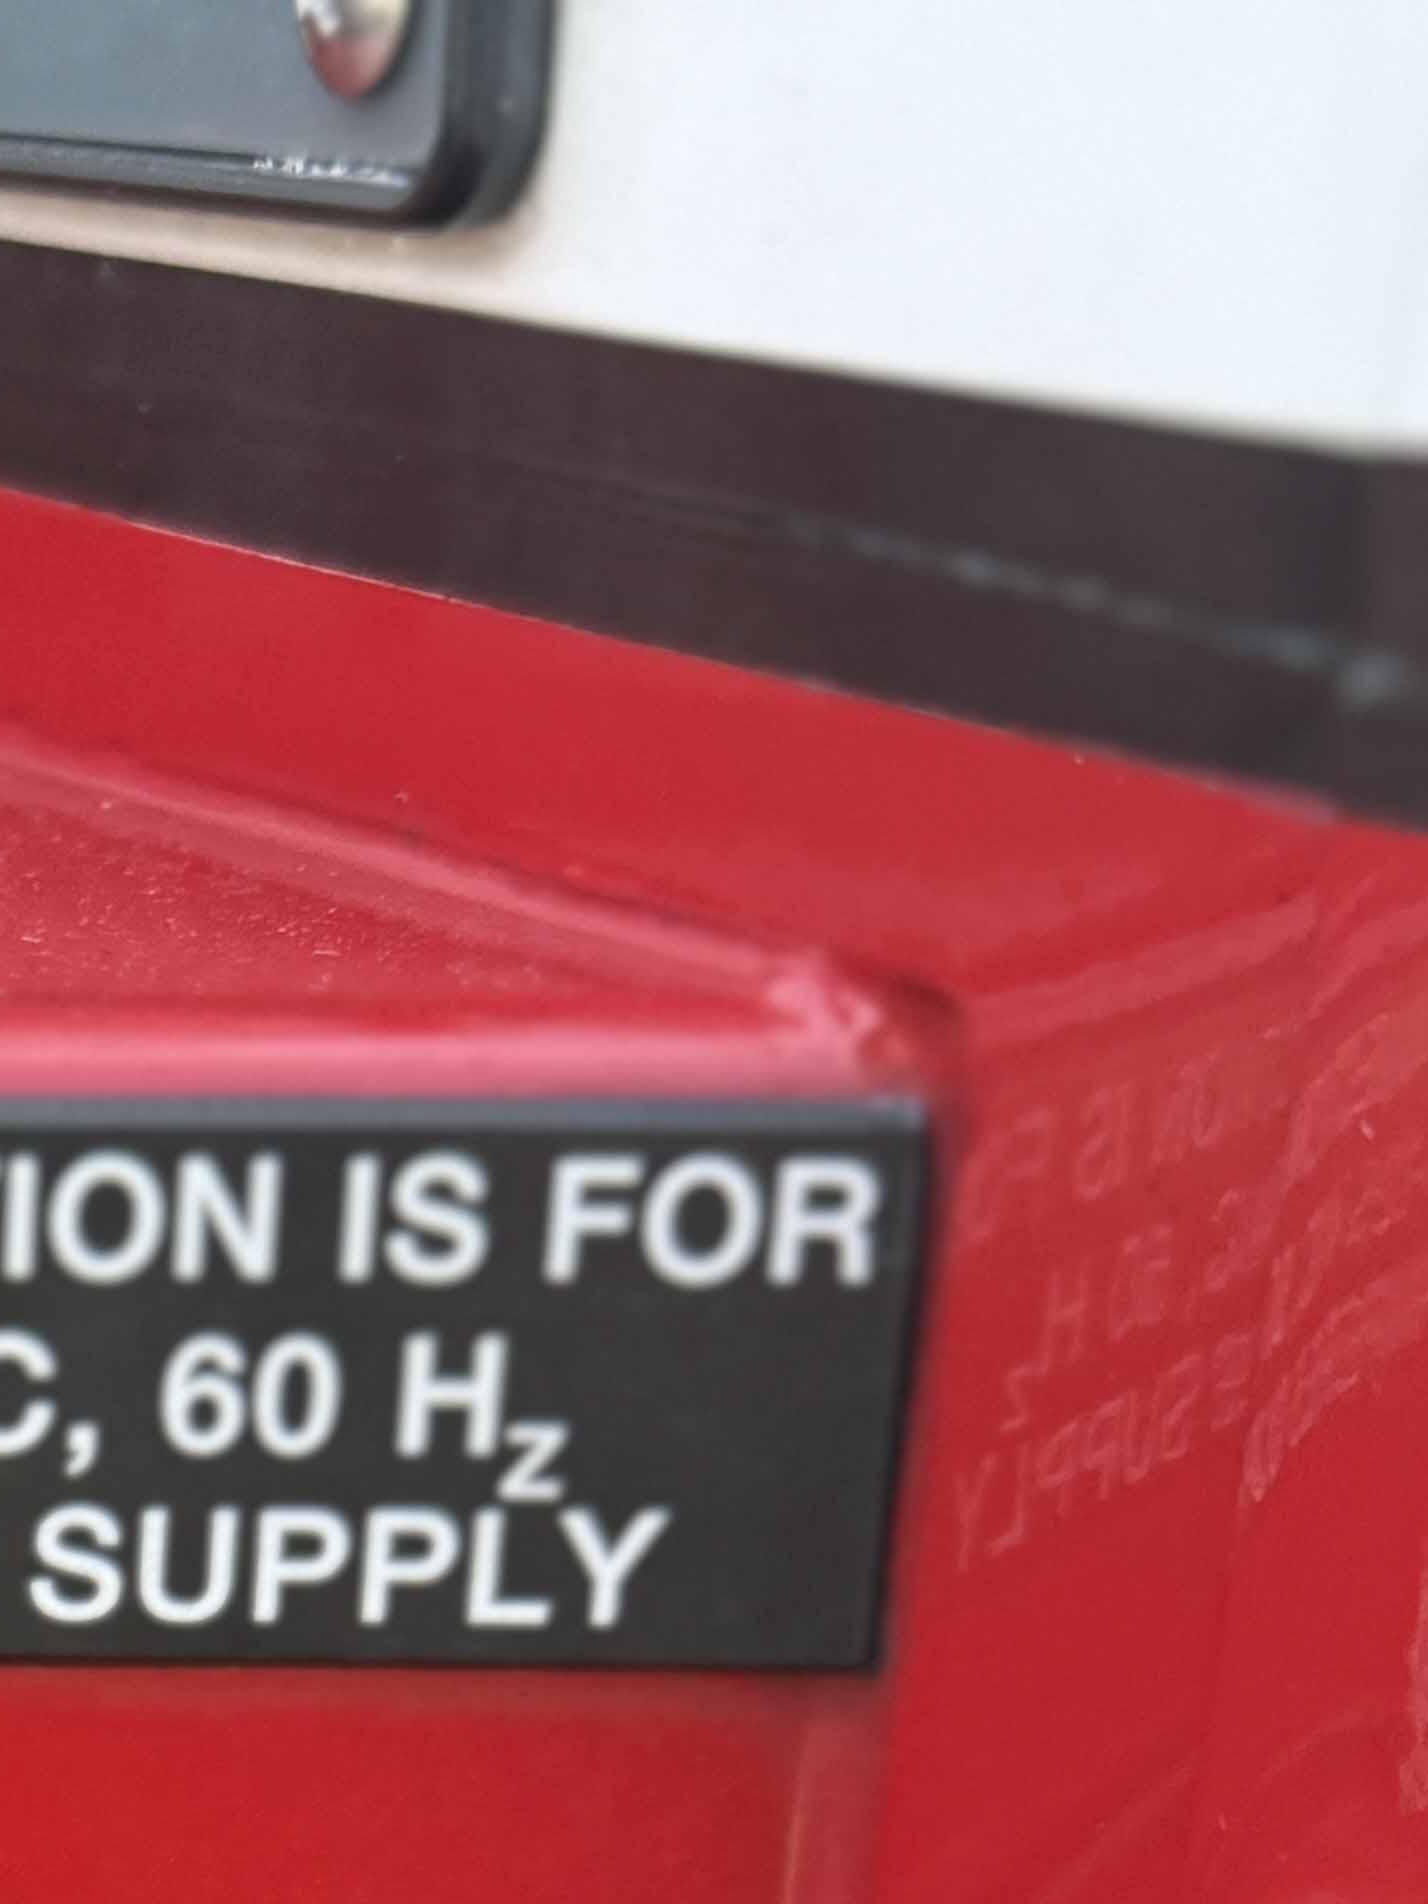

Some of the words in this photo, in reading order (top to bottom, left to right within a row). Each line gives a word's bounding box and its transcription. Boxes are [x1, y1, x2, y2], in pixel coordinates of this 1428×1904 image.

[338, 1152, 488, 1285] IS
[543, 1154, 881, 1288] FOR
[159, 1333, 342, 1458] 60
[394, 1333, 567, 1502] Hz
[27, 1503, 669, 1629] SUPPLY
